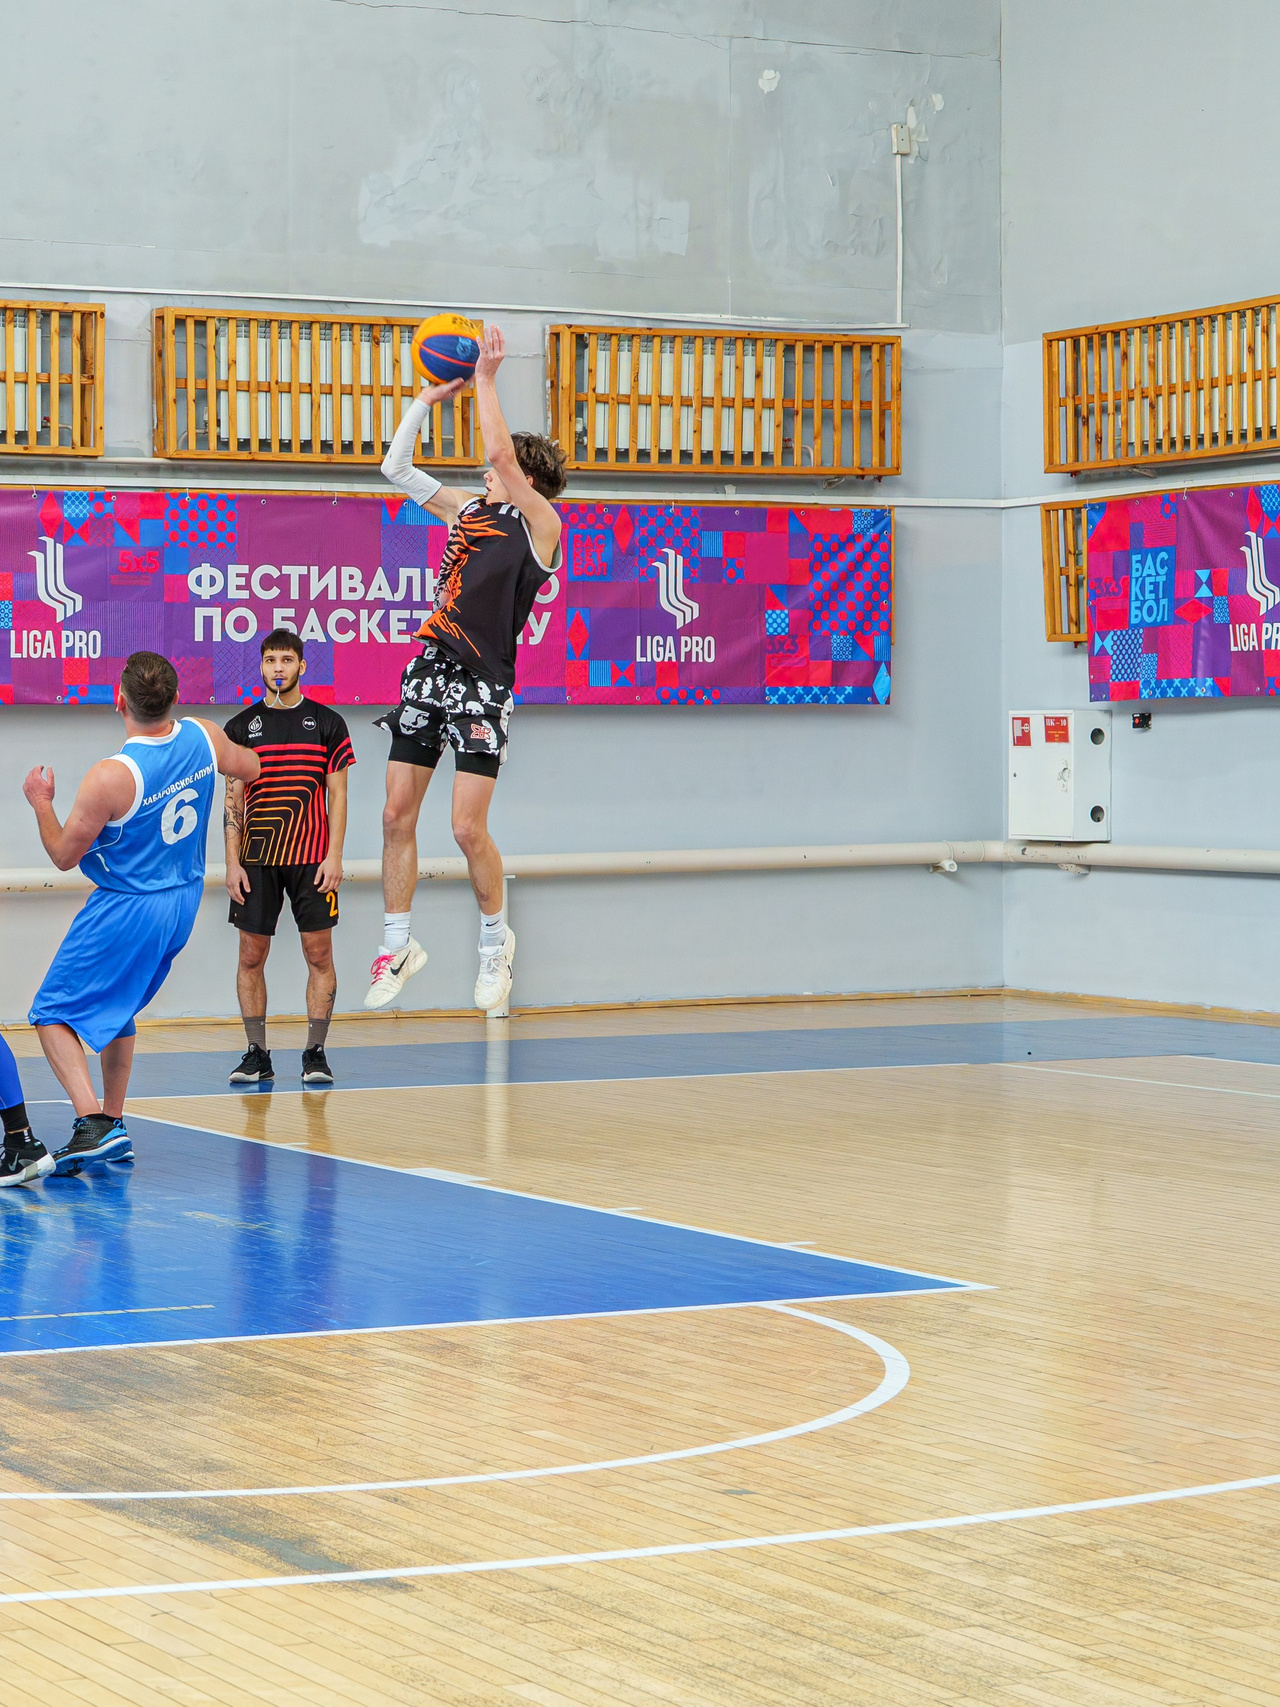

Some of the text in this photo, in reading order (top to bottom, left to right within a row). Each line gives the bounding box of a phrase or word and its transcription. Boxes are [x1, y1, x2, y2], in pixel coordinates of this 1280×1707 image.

[573, 534, 606, 548] БАС
[118, 550, 160, 573] 5x5
[573, 548, 605, 562] КЕТ
[1131, 551, 1169, 578] БАС
[573, 562, 608, 577] БОЛ
[1131, 575, 1167, 601] КЕТ
[194, 606, 258, 643] ПО
[1130, 598, 1168, 624] БОЛ
[10, 629, 102, 659] LIGA PRO
[636, 635, 716, 663] LIGA PRO
[1229, 622, 1259, 652] LIGA
[142, 776, 194, 807] ХАБАРОВСКОЕ
[161, 788, 199, 846] 6
